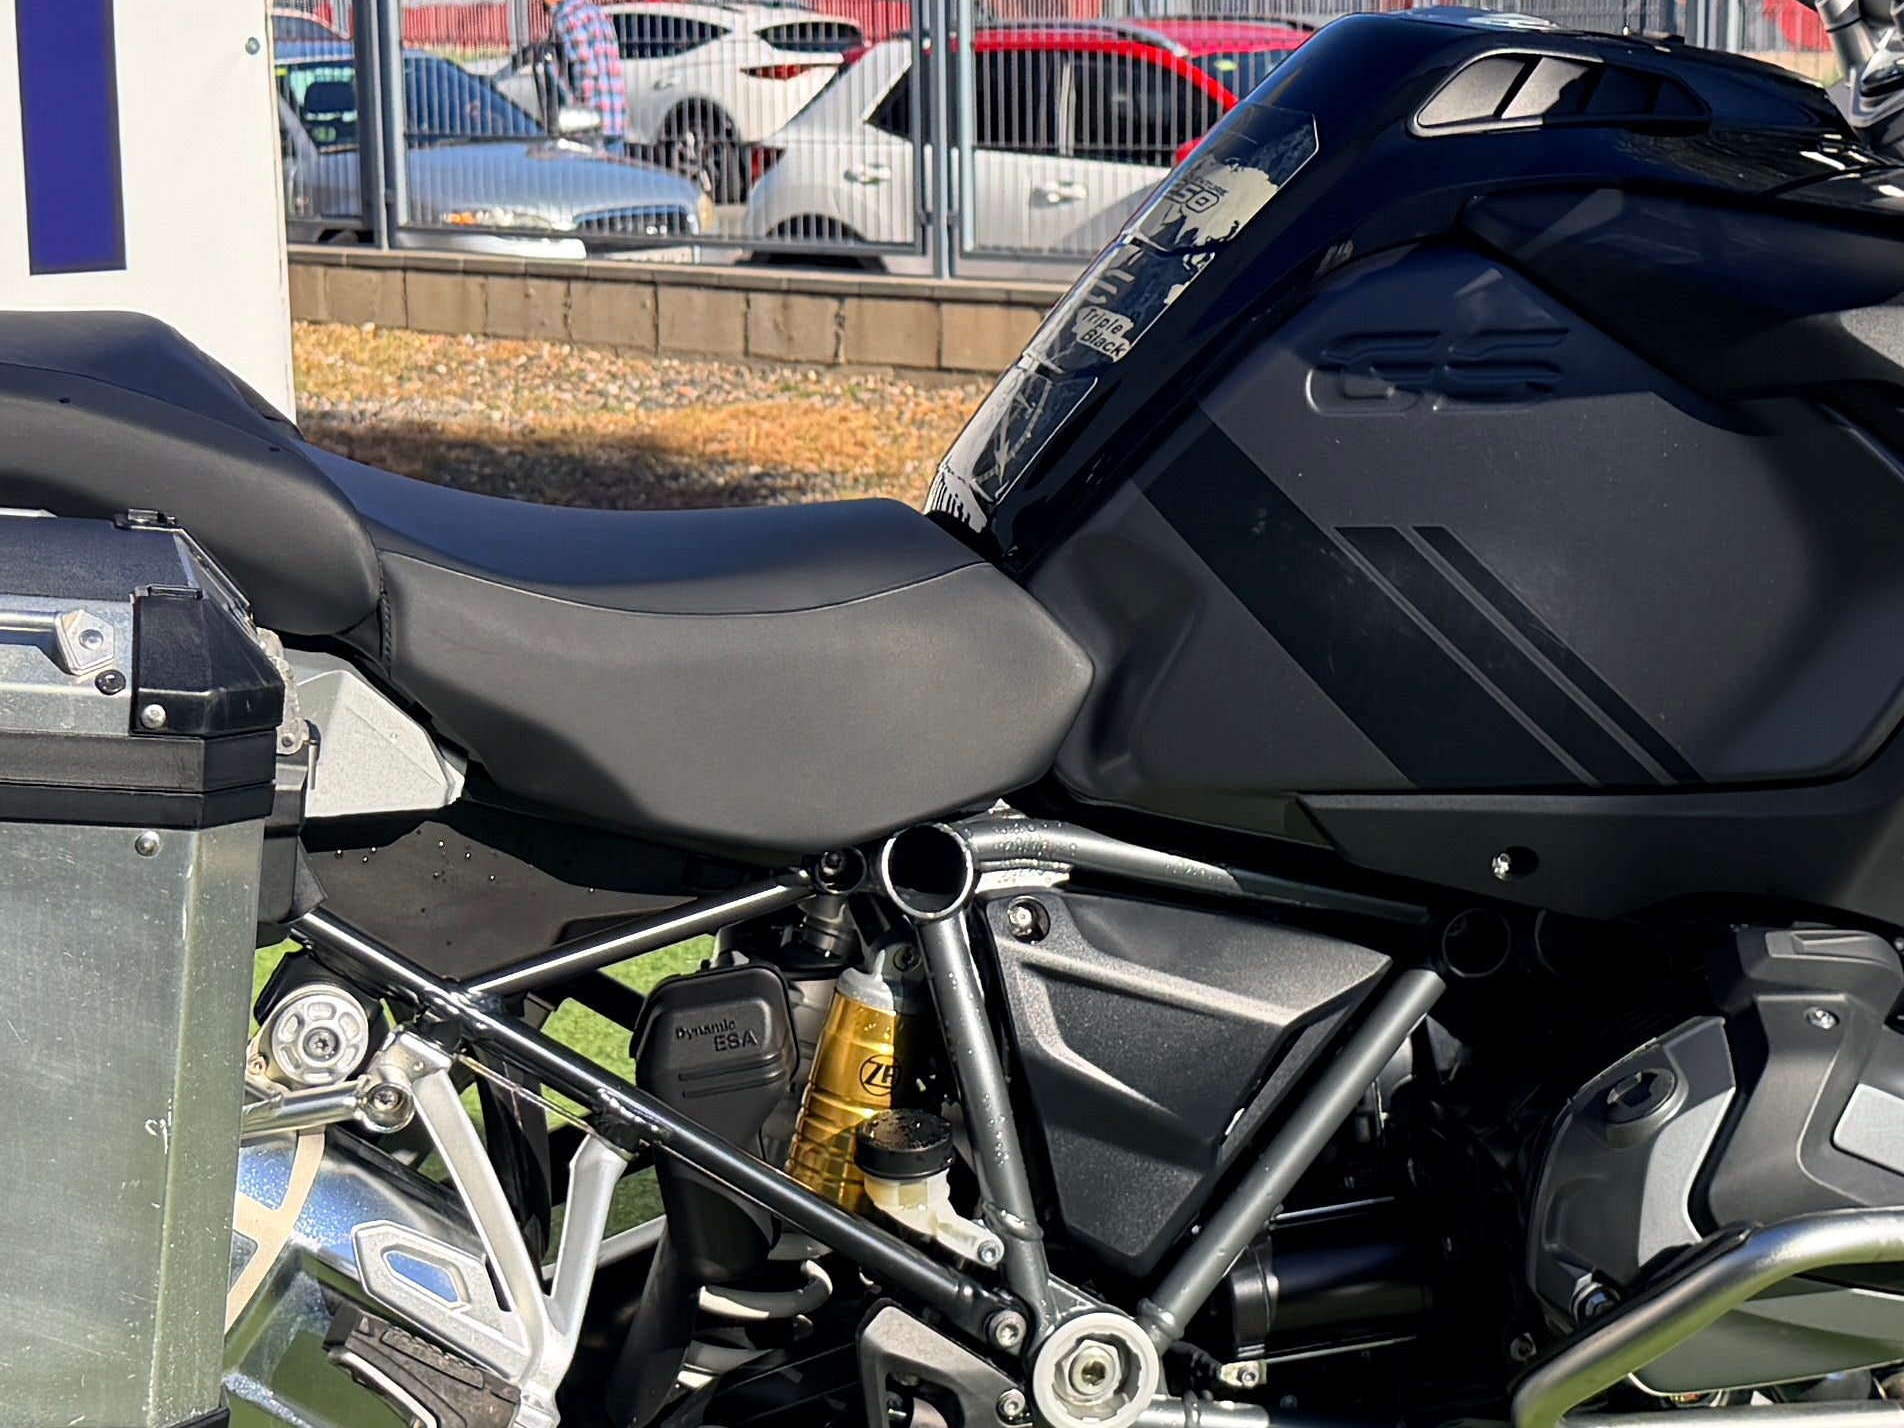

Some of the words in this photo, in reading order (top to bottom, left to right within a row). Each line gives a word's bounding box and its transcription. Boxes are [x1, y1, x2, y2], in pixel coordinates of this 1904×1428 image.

[1081, 307, 1124, 335] Triple
[1080, 328, 1126, 358] Black
[1304, 326, 1570, 417] GS
[675, 1018, 737, 1041] Dynamic
[714, 1029, 759, 1053] ESA
